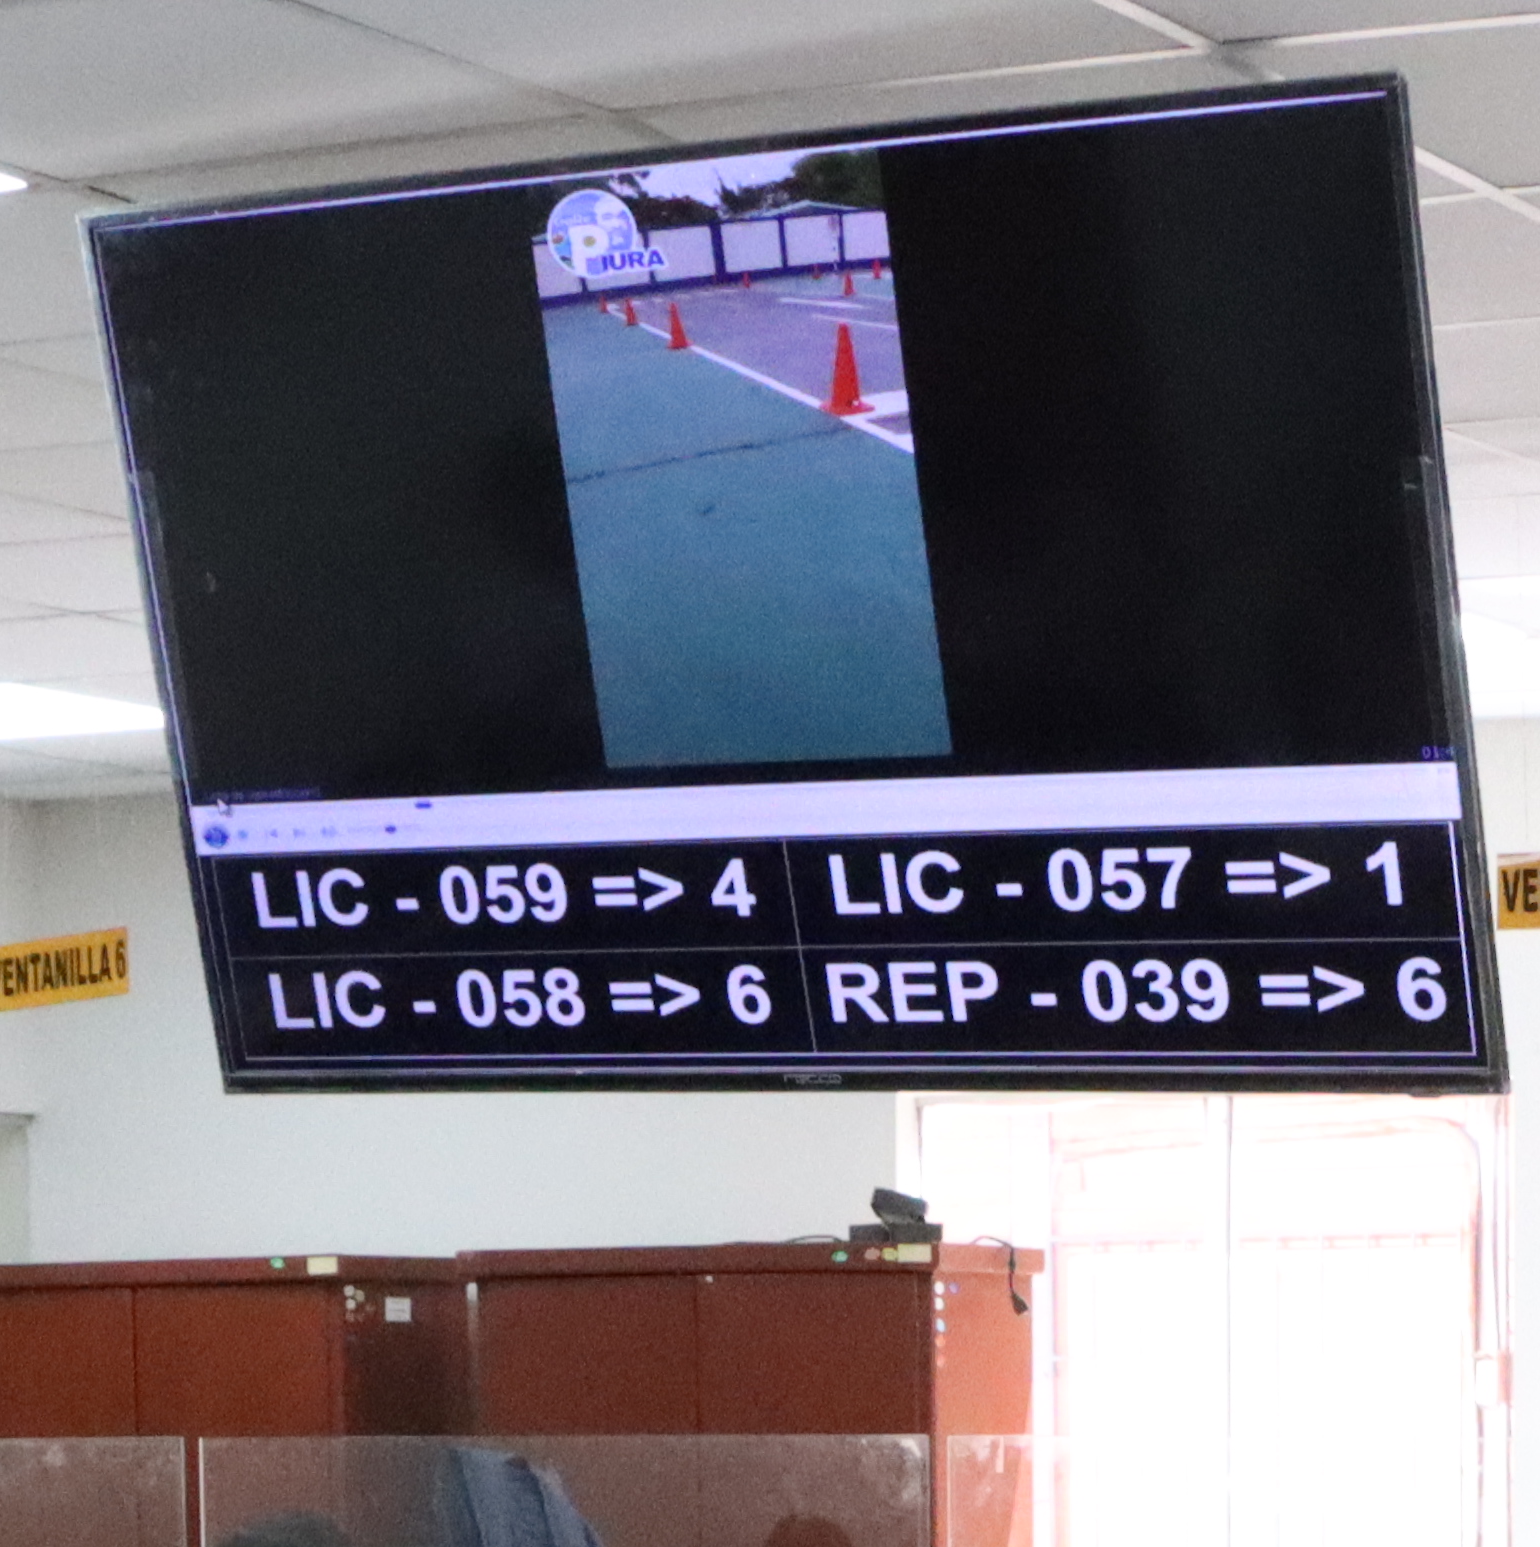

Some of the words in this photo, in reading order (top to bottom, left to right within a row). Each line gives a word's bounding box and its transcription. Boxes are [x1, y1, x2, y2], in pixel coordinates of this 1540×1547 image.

[251, 867, 370, 930] LIC
[439, 863, 568, 925] 059
[711, 858, 757, 917] 4
[828, 851, 965, 915] LIC
[1047, 846, 1192, 913] 057
[1365, 840, 1404, 907] 1
[115, 939, 126, 979] 6
[825, 960, 999, 1024] REP
[1081, 957, 1230, 1024] 039
[1397, 956, 1448, 1022] 6
[268, 969, 386, 1029] LIC
[456, 967, 586, 1028] 058
[727, 964, 772, 1025] 6
